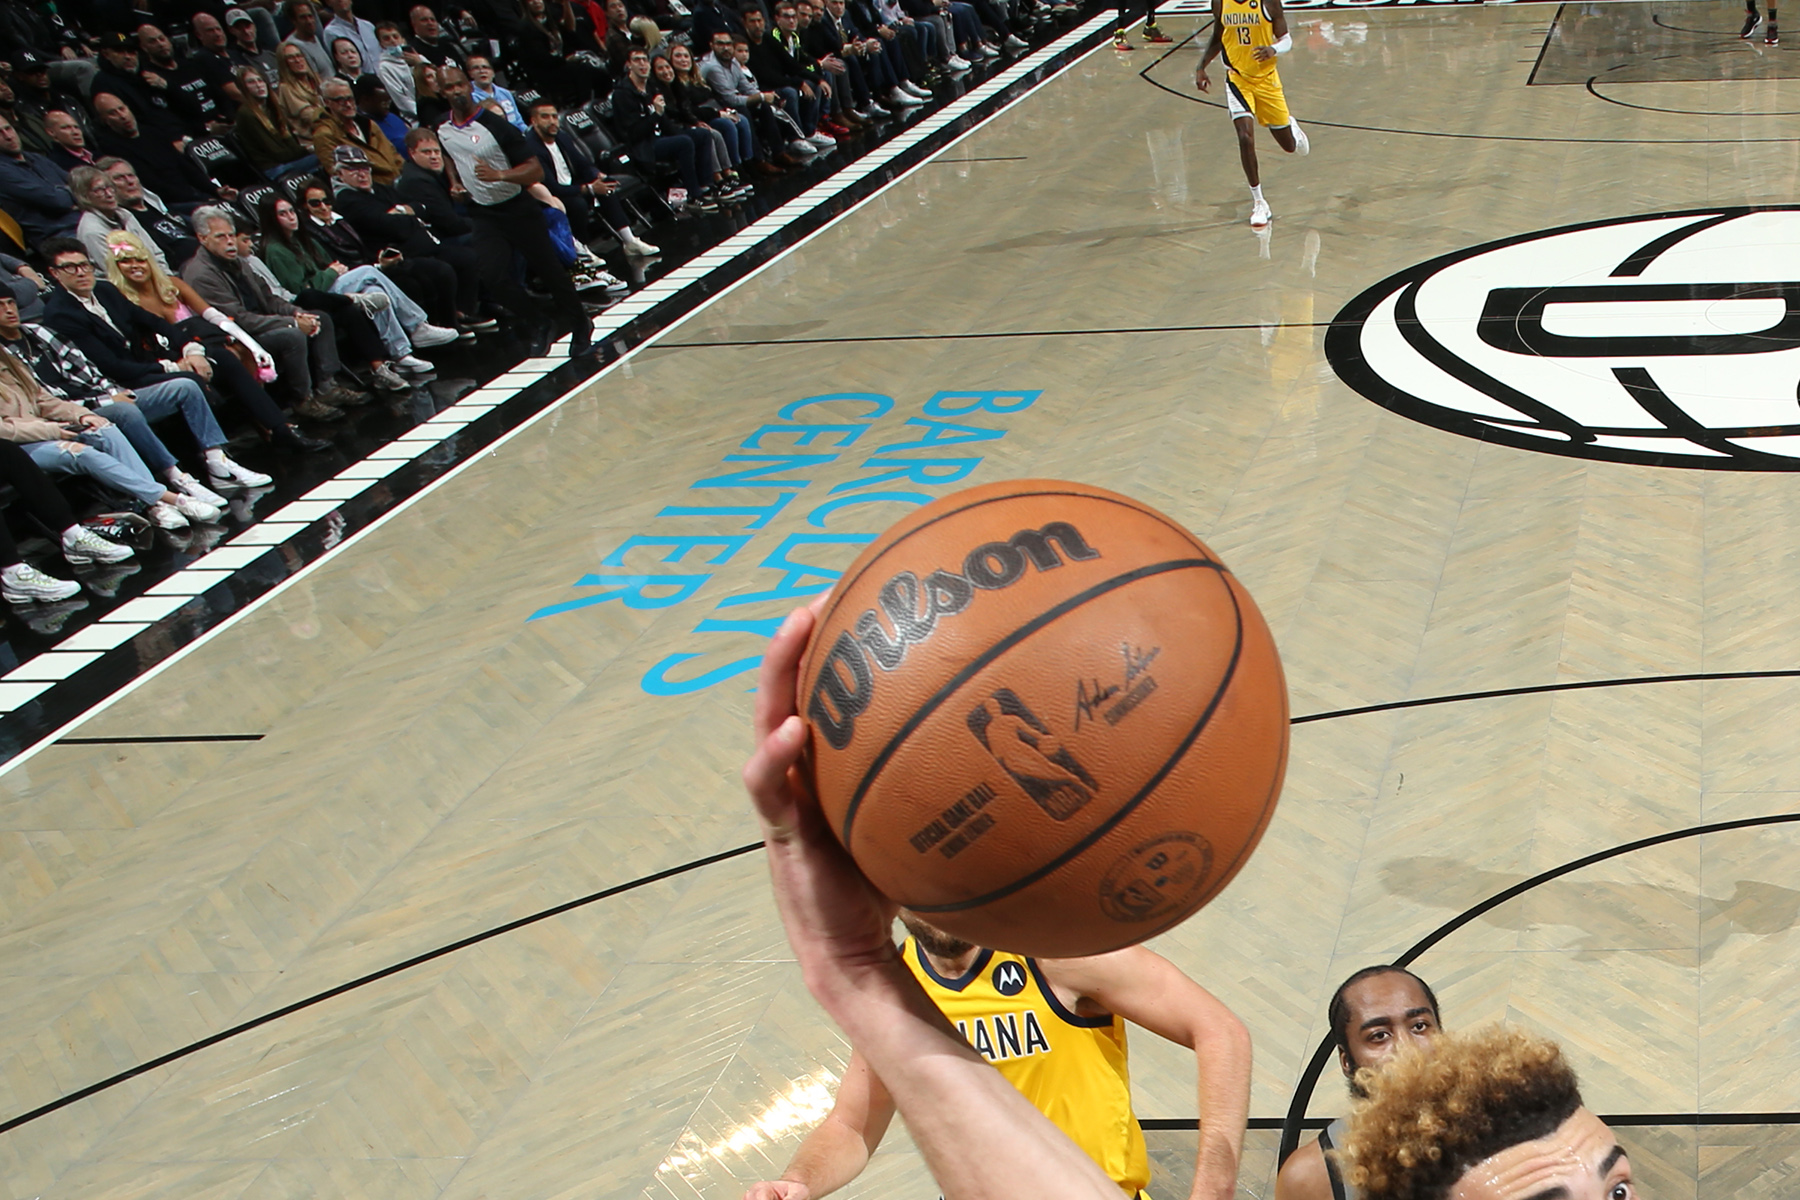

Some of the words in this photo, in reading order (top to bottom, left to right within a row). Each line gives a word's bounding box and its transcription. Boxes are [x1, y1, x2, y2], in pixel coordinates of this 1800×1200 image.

[1223, 12, 1261, 26] INDIANA
[1236, 26, 1252, 45] 13
[566, 110, 590, 126] QATAR
[193, 138, 225, 159] QATAR
[525, 392, 896, 623] CENTER
[807, 521, 1102, 750] Wilson
